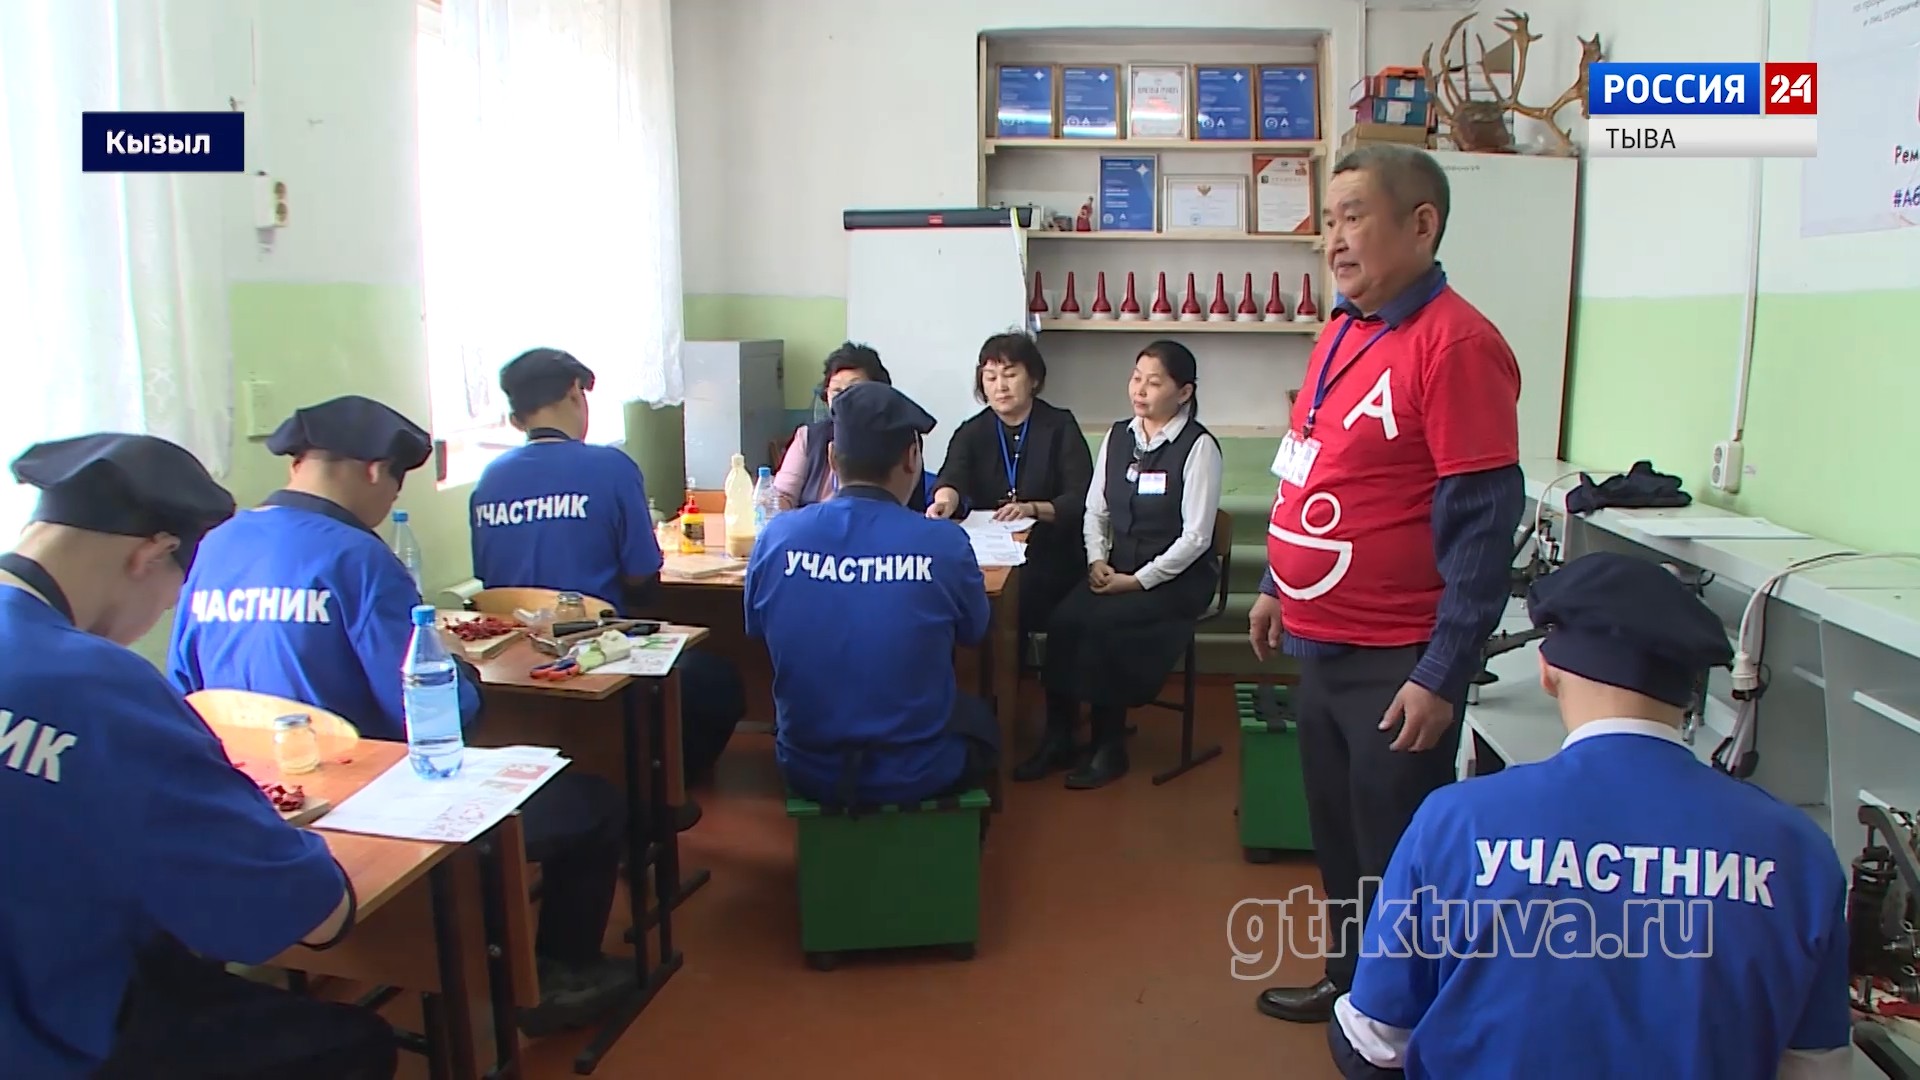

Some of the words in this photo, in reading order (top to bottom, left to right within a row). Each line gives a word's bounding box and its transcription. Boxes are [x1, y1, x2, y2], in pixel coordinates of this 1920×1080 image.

[476, 493, 589, 528] УЧАСТНИК
[784, 550, 933, 583] УЧАСТНИК
[1475, 838, 1776, 907] УЧАСТНИК
